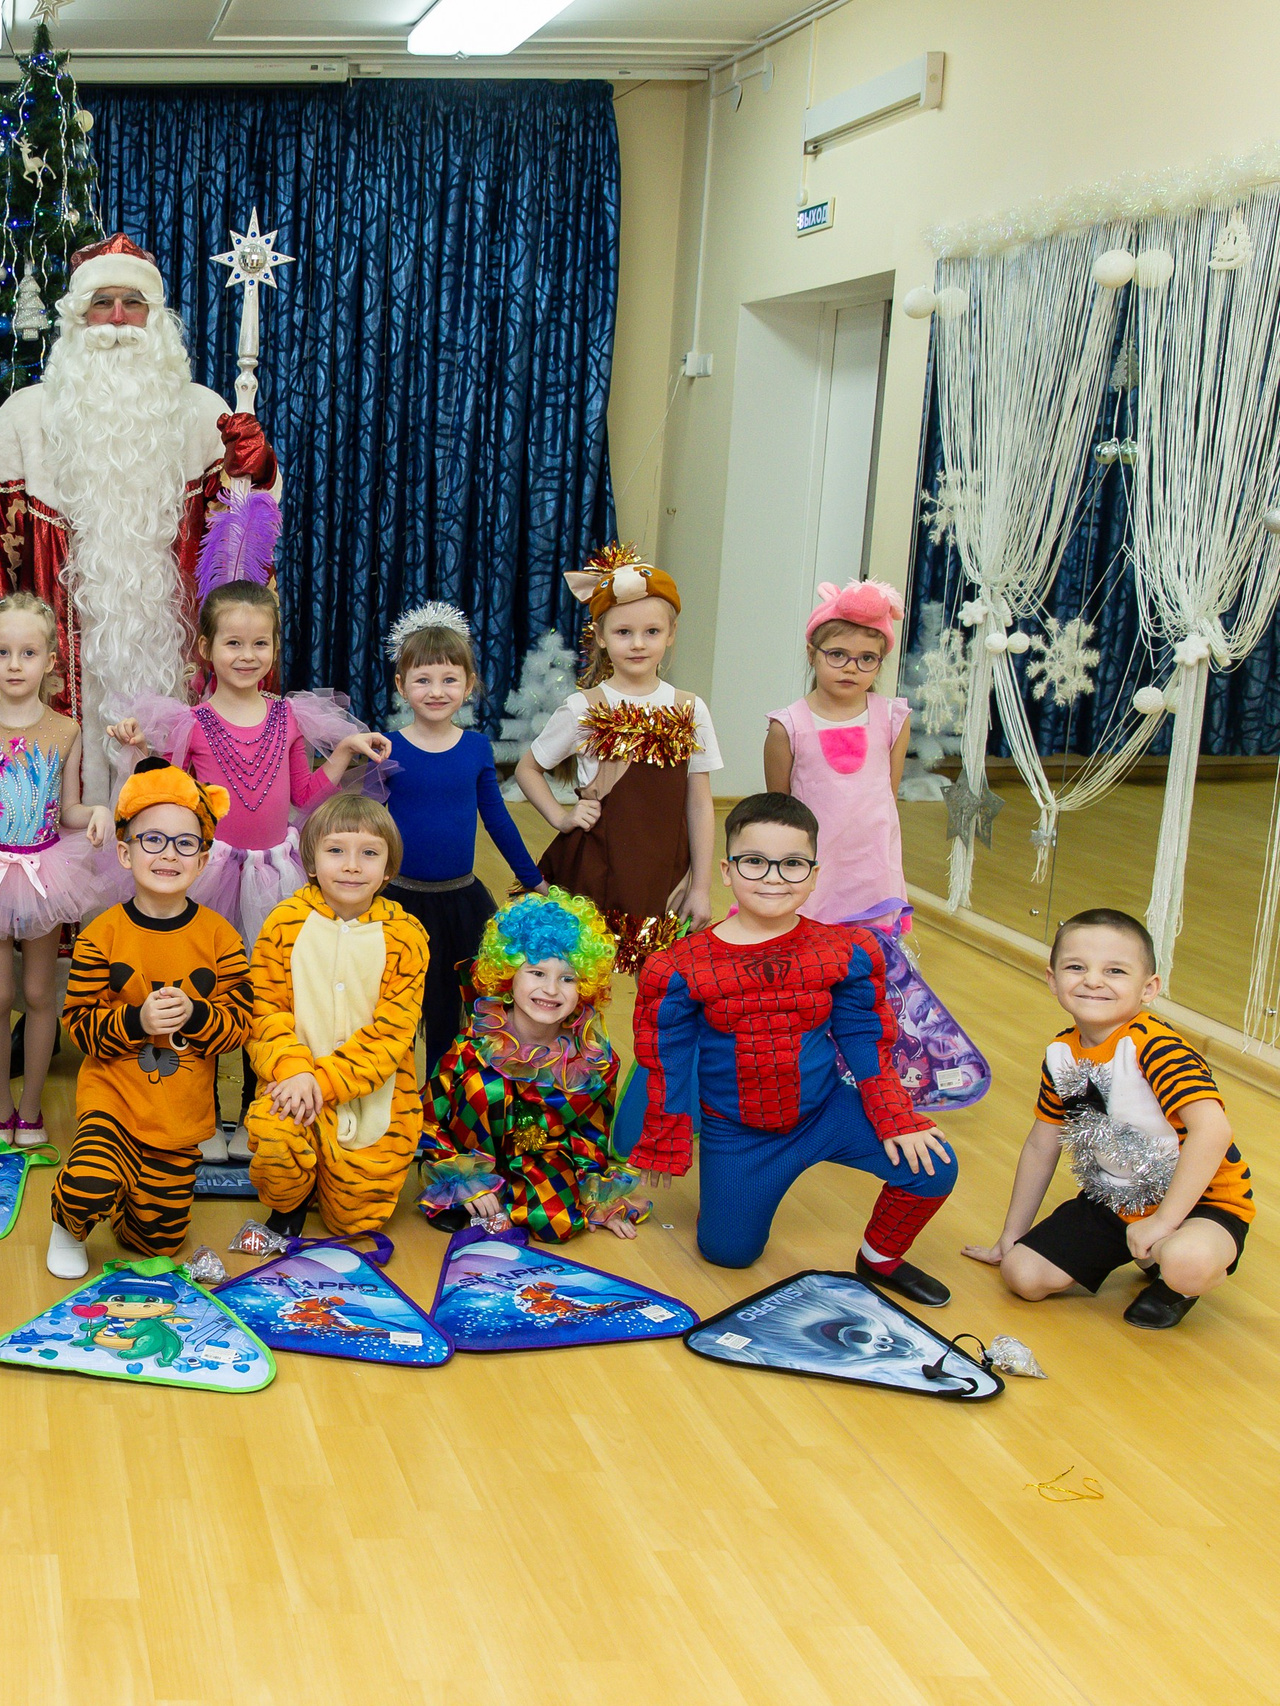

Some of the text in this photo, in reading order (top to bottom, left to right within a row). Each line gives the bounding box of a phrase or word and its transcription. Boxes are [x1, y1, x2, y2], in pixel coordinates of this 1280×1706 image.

[798, 206, 828, 229] ВЫХОД
[258, 1276, 379, 1292] SIAPRO
[459, 1264, 565, 1289] SIAPRO
[736, 1287, 804, 1322] SILAPRO
